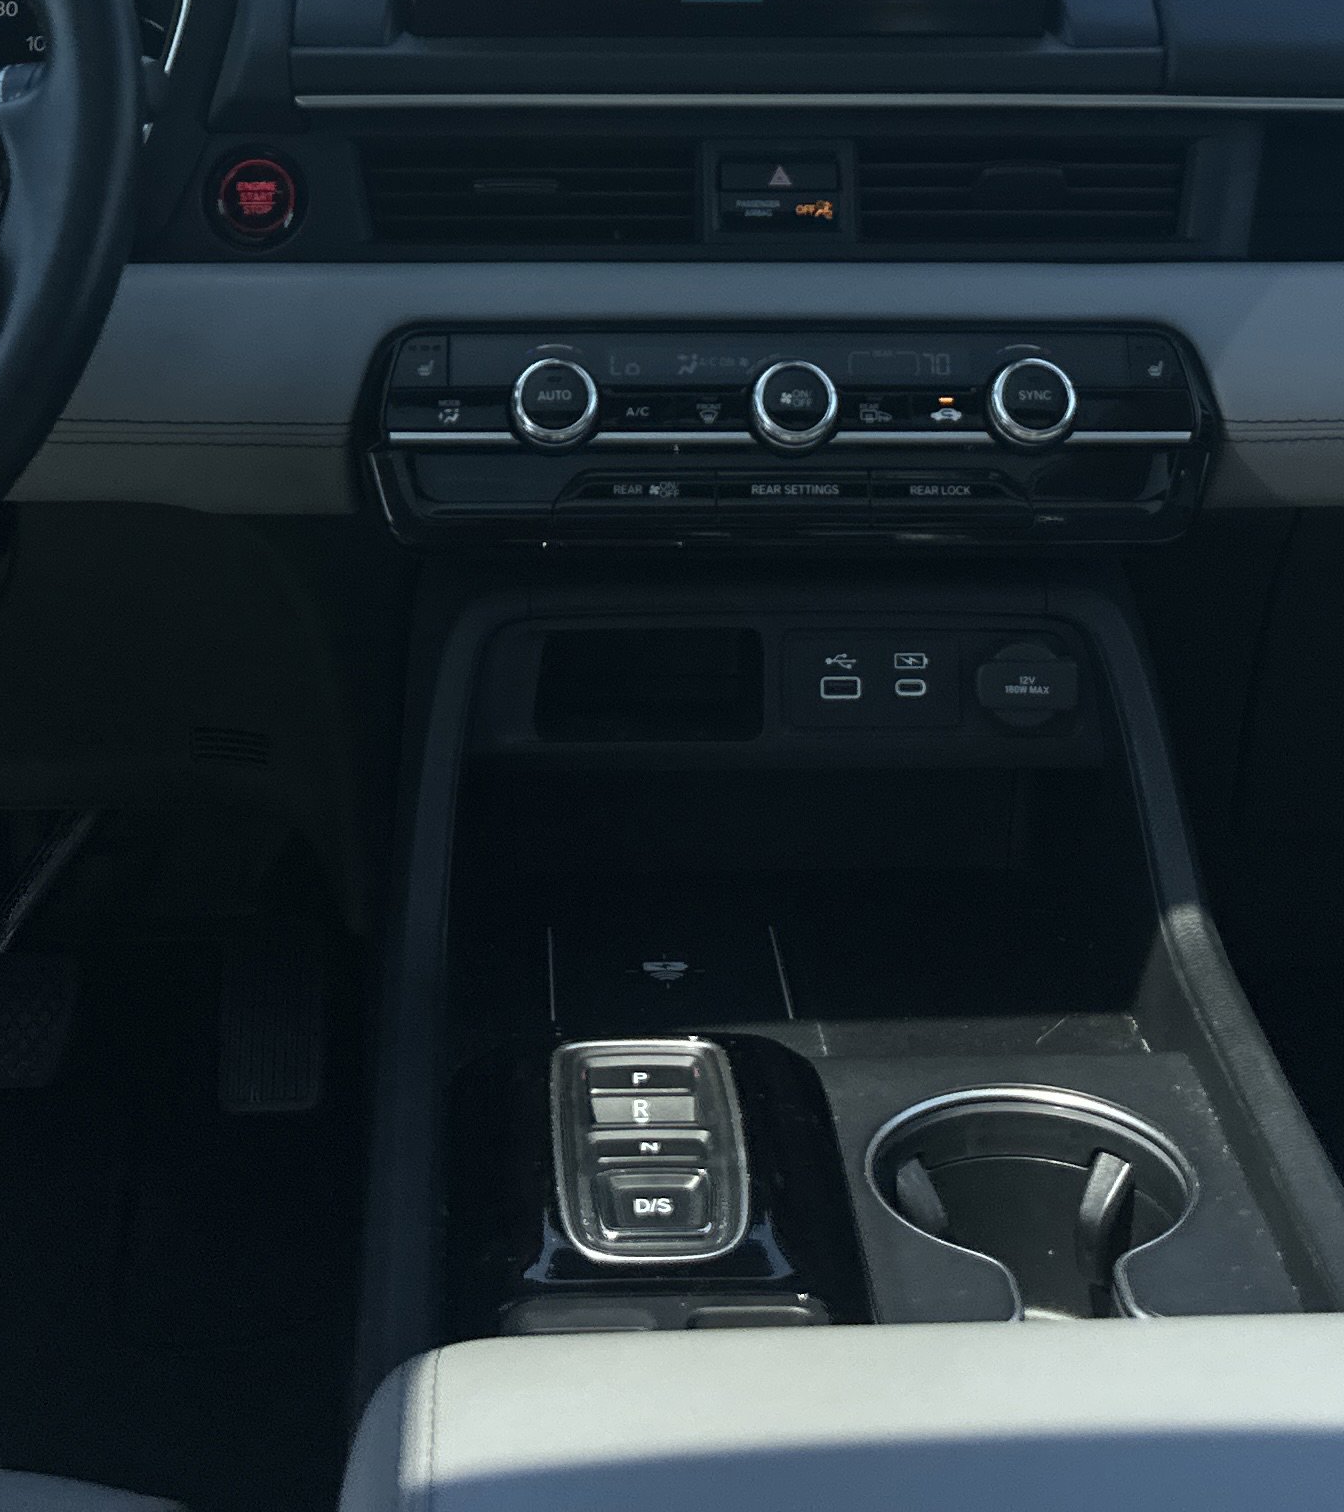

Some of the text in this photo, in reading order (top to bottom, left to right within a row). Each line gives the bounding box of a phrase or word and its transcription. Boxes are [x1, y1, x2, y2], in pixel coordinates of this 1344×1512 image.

[239, 192, 273, 202] START
[795, 203, 816, 216] OFF
[536, 389, 573, 402] AUTO
[1018, 389, 1053, 402] SYNC
[625, 406, 651, 418] A/C
[613, 484, 643, 495] REAR
[751, 484, 840, 496] REAR SETTINGS
[909, 484, 972, 496] REAR LOCK
[1029, 684, 1050, 694] MAX
[630, 1070, 650, 1087] P
[632, 1098, 650, 1119] R
[638, 1140, 662, 1155] N
[632, 1195, 675, 1218] D/S
